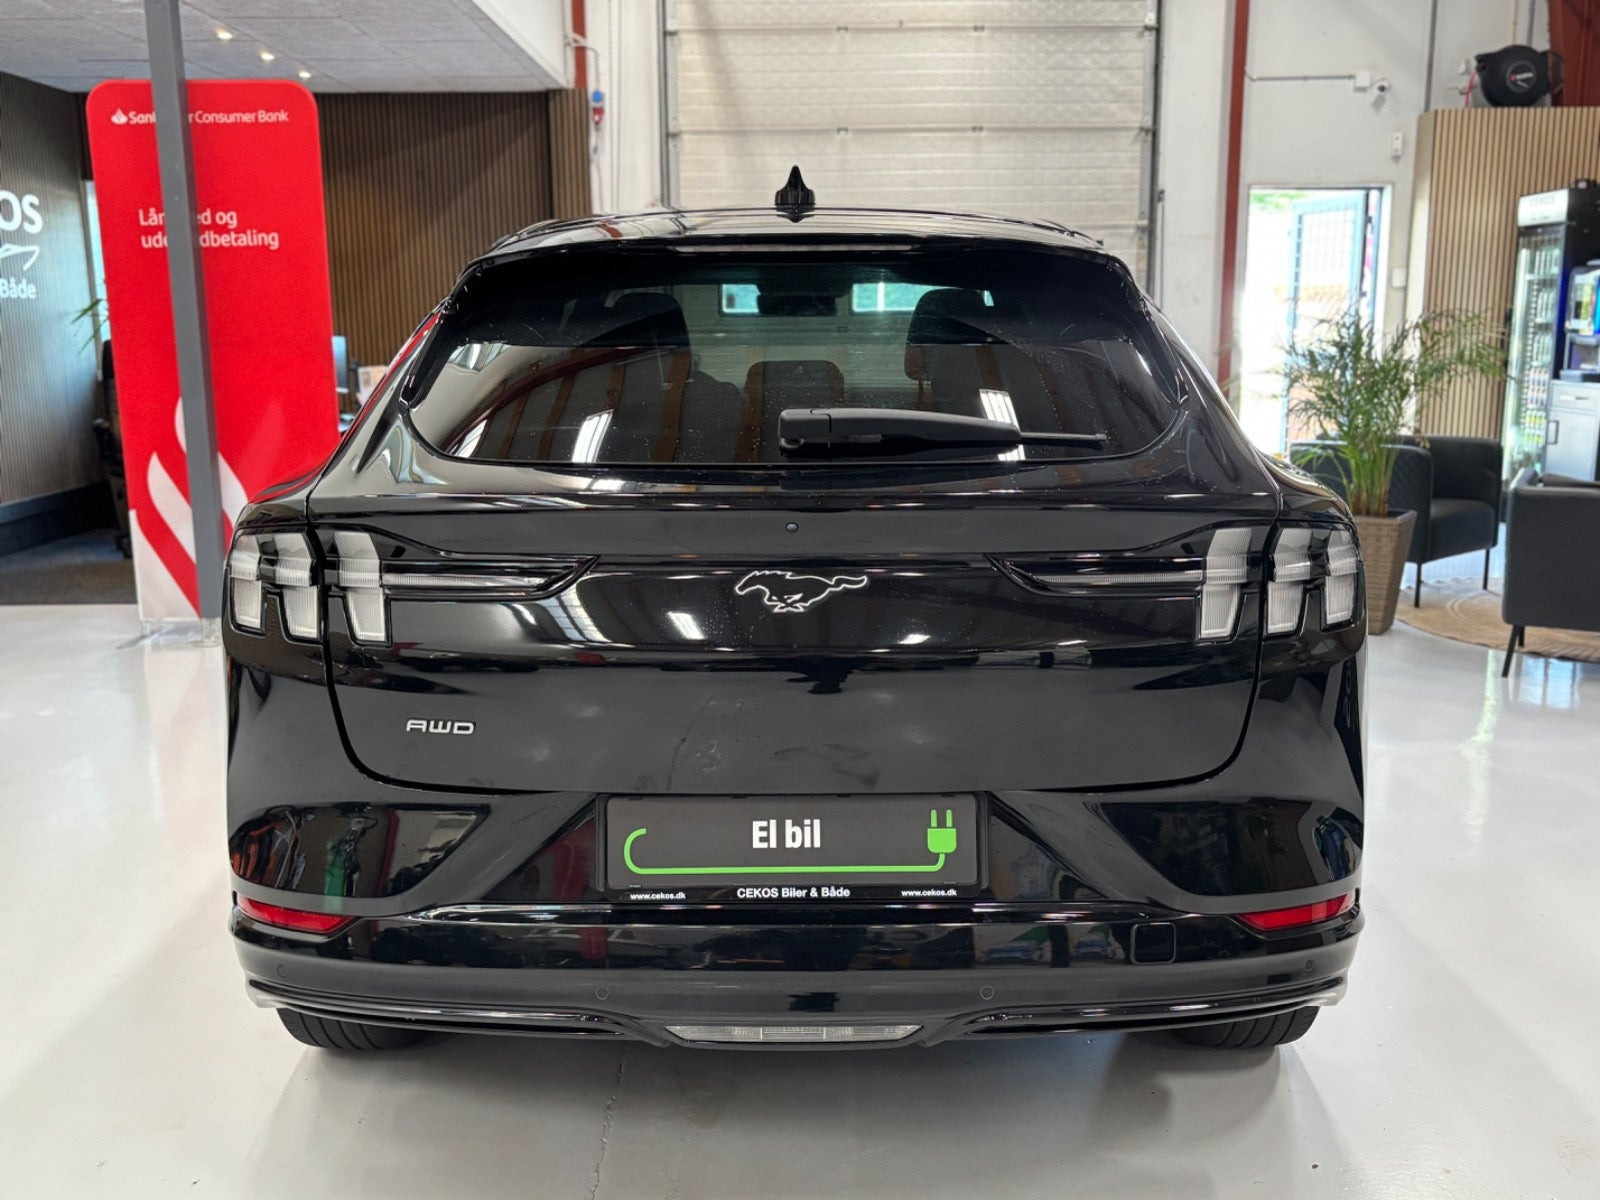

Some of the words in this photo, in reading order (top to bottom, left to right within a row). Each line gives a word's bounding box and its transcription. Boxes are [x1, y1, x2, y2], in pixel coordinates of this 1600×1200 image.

[195, 110, 255, 124] Consumer
[258, 110, 289, 123] Bank
[215, 211, 238, 229] og
[199, 229, 280, 250] dbetaling
[406, 719, 475, 735] AWD
[752, 819, 777, 849] El
[785, 819, 821, 849] bil
[630, 891, 687, 900] www.cekos.dk
[737, 887, 779, 898] CEKOS
[781, 887, 808, 898] Biler
[810, 887, 818, 898] &
[821, 886, 850, 897] Både
[901, 889, 958, 897] www.cekos.dk
